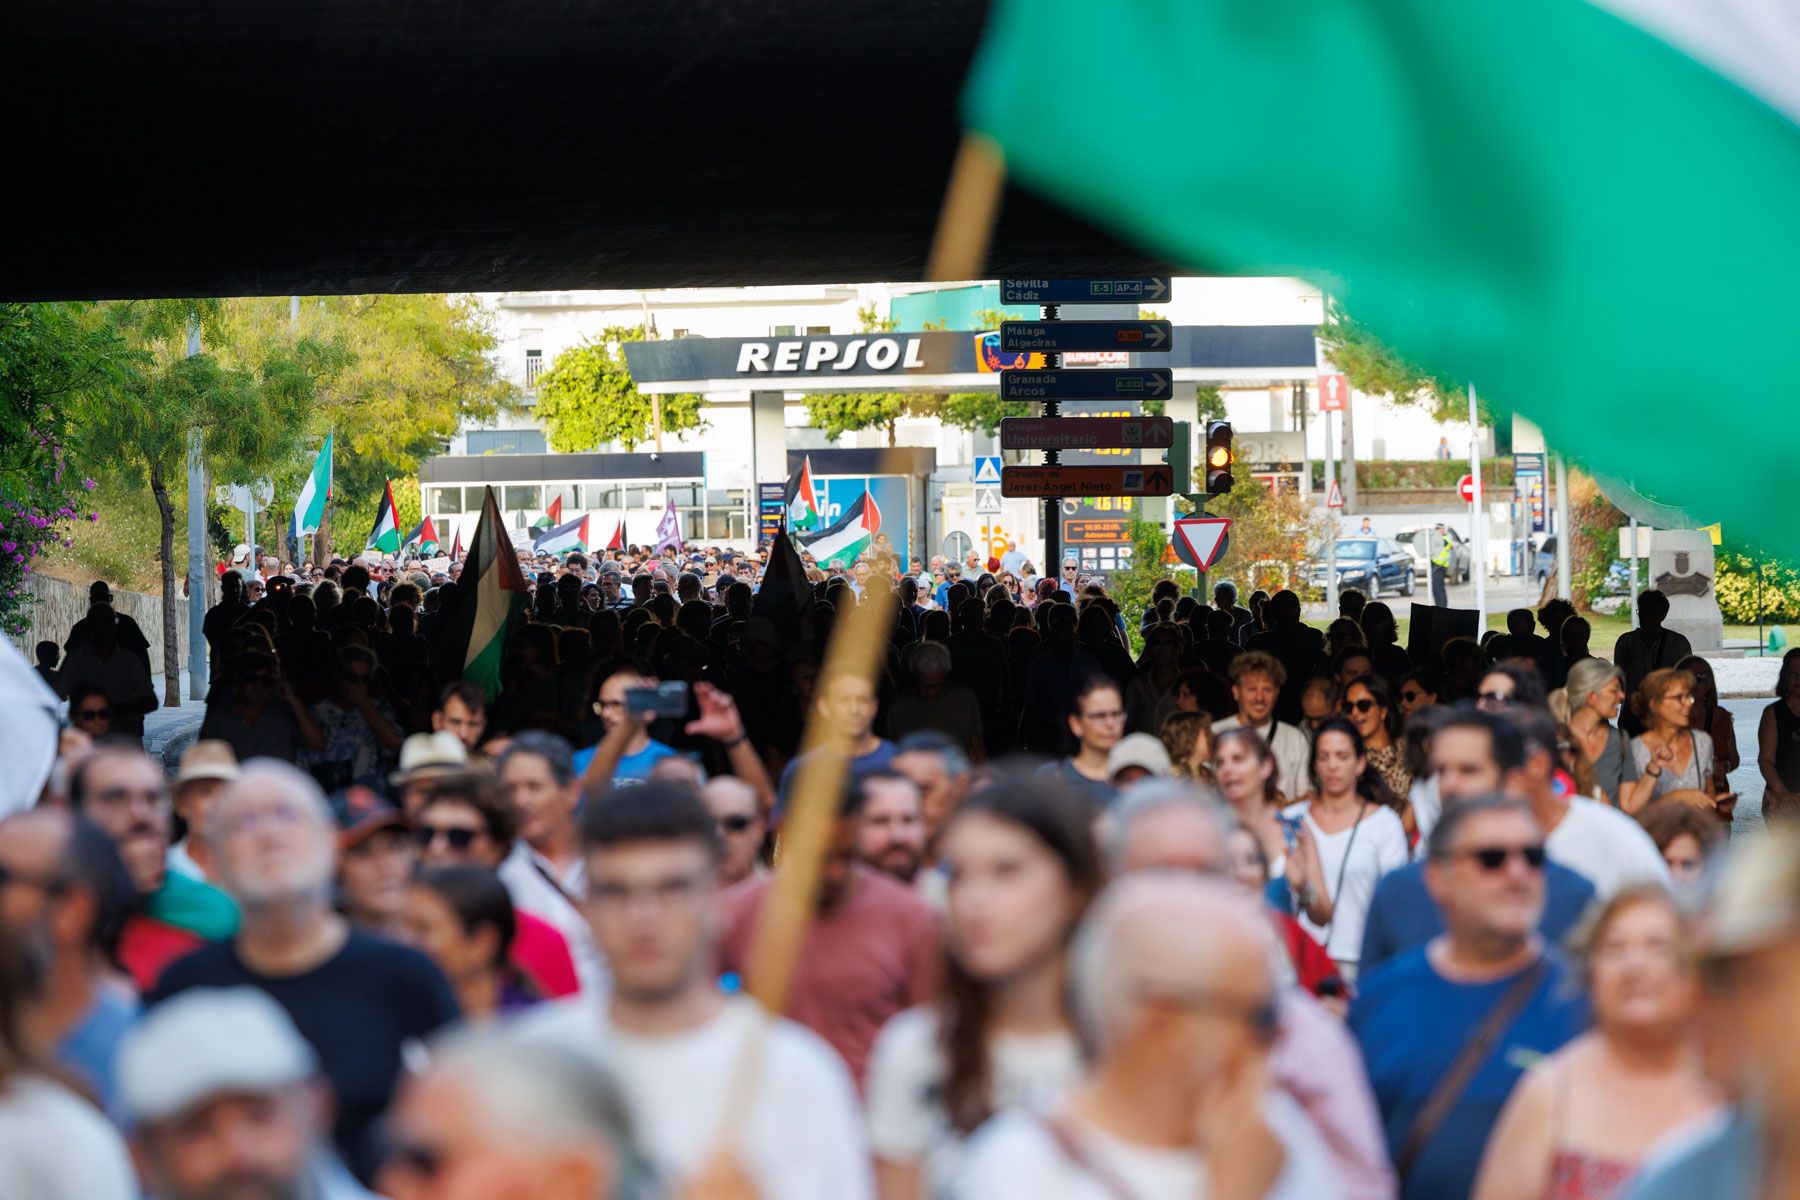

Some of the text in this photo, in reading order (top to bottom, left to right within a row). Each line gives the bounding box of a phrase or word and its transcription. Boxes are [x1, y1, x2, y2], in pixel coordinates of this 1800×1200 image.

[1006, 279, 1049, 288] Sevilla
[1093, 283, 1109, 292] E-5
[1117, 283, 1140, 292] AP-4
[1006, 289, 1039, 300] Cádiz
[1007, 326, 1046, 336] Málaga
[1008, 338, 1057, 348] Algeciras
[736, 338, 924, 372] REPSOL
[1008, 374, 1057, 384] Granada
[1009, 385, 1046, 396] Arcos
[1007, 422, 1044, 432] Campus
[1007, 433, 1098, 445] Universitario
[1007, 470, 1059, 478] Circuito de
[1081, 482, 1112, 491] Nieto
